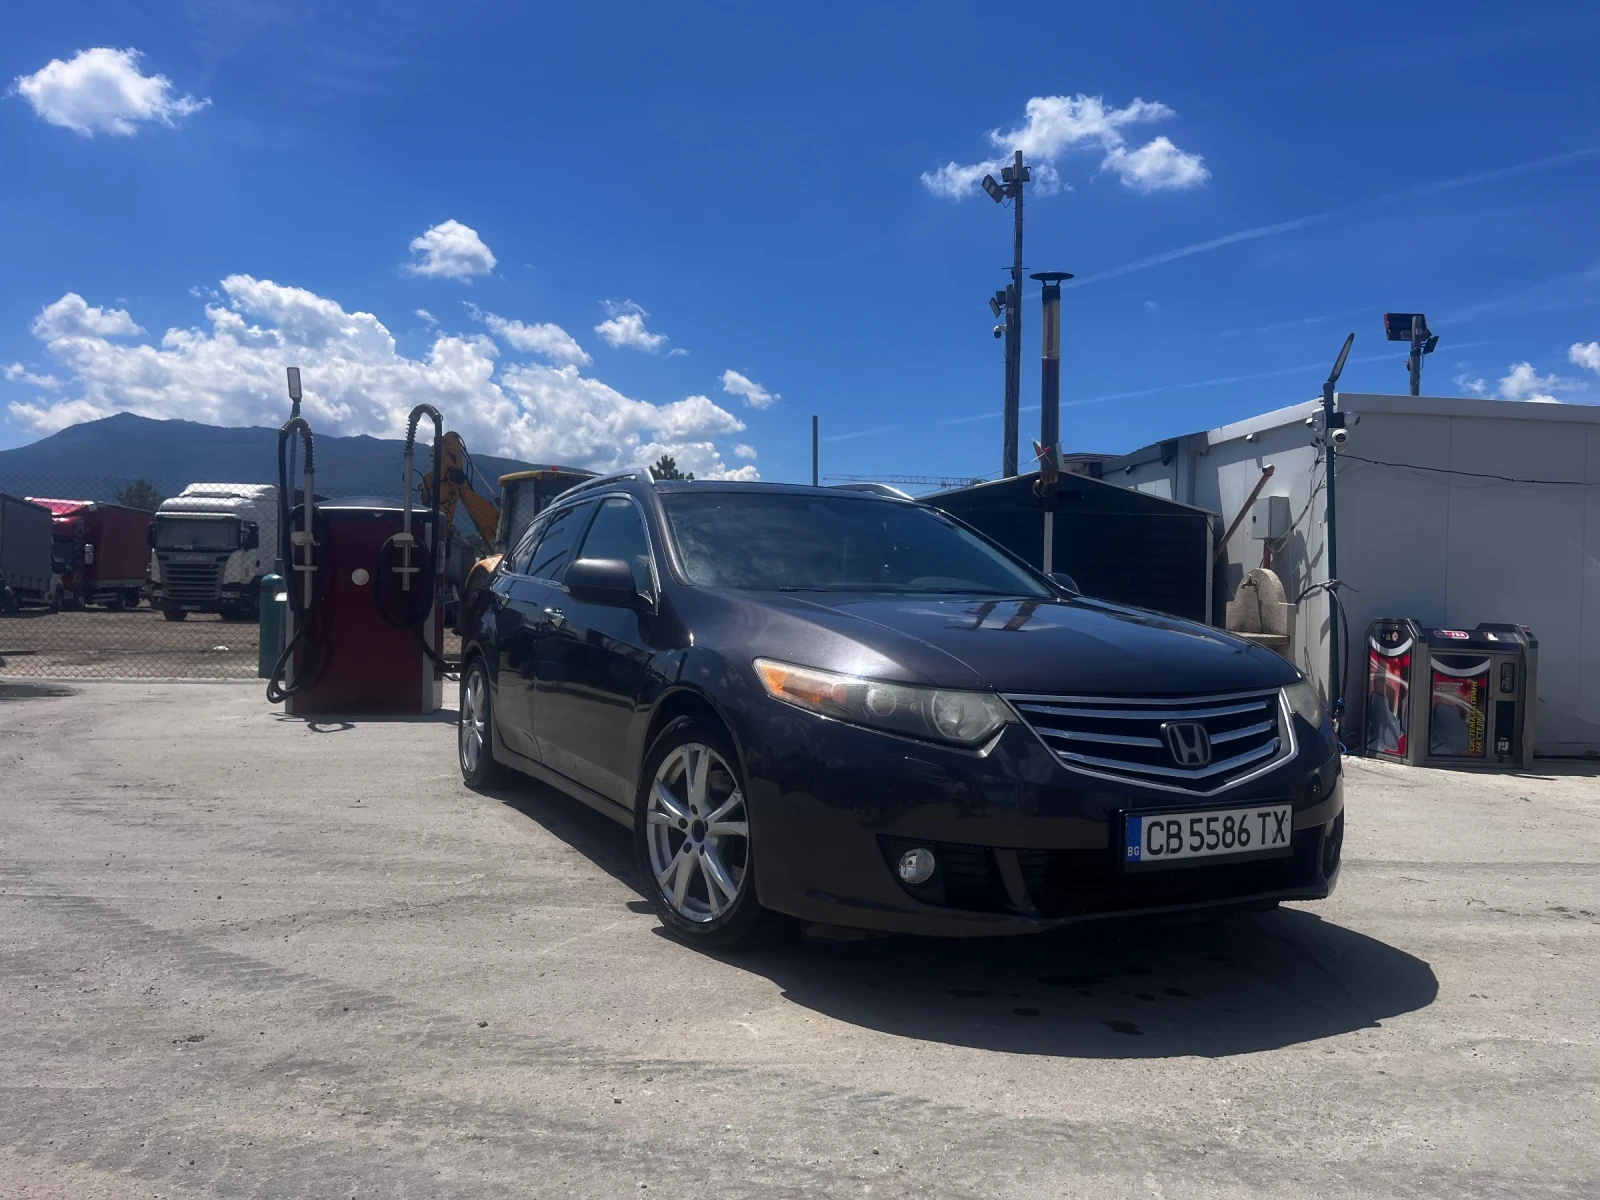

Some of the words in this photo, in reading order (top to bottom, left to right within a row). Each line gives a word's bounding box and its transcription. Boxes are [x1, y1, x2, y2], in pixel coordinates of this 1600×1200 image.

[1470, 679, 1478, 705] ПРАНЕ
[1469, 705, 1476, 715] ЗА
[1468, 716, 1476, 752] СИСТЕМА
[1476, 711, 1484, 740] СТЕЛКИ
[1475, 741, 1482, 752] НА
[1146, 820, 1183, 856] CB
[1189, 814, 1251, 852] 5586
[1257, 810, 1287, 845] TX
[1127, 846, 1140, 857] BG
